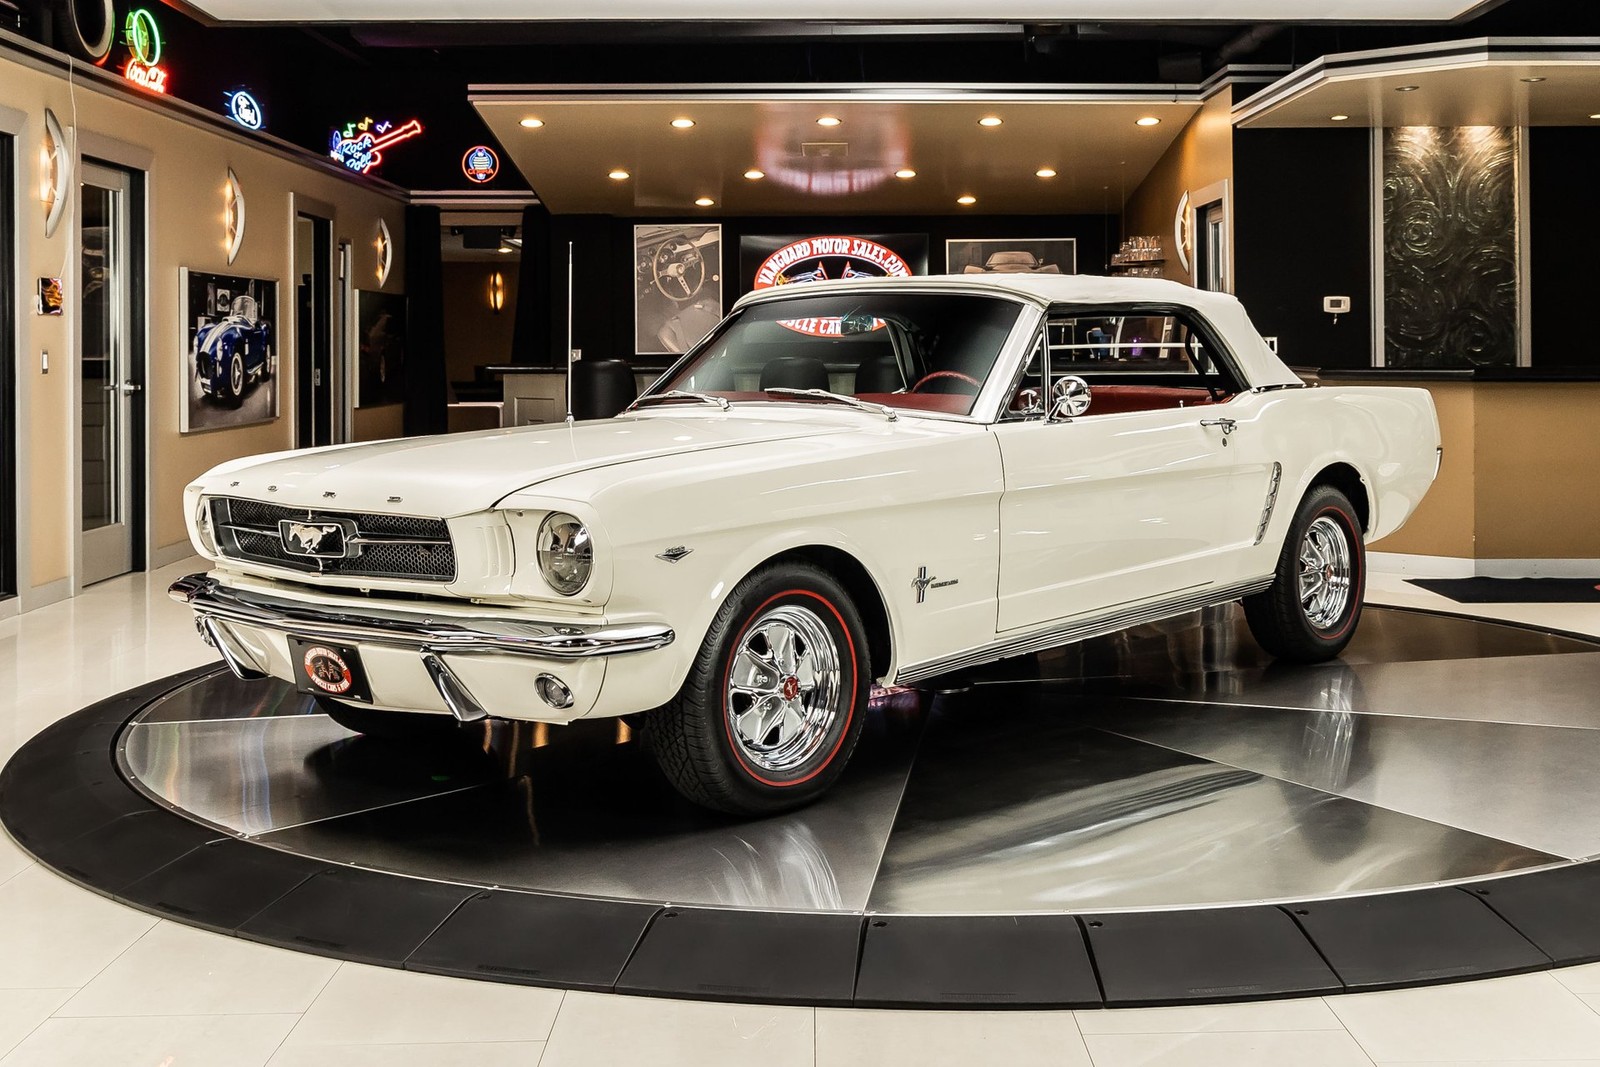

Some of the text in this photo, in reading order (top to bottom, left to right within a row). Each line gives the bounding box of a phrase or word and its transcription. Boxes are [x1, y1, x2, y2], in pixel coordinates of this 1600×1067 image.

[341, 135, 372, 155] Rock
[758, 242, 811, 284] VANGUARD
[811, 238, 851, 254] MOTOR
[820, 318, 842, 335] CAR
